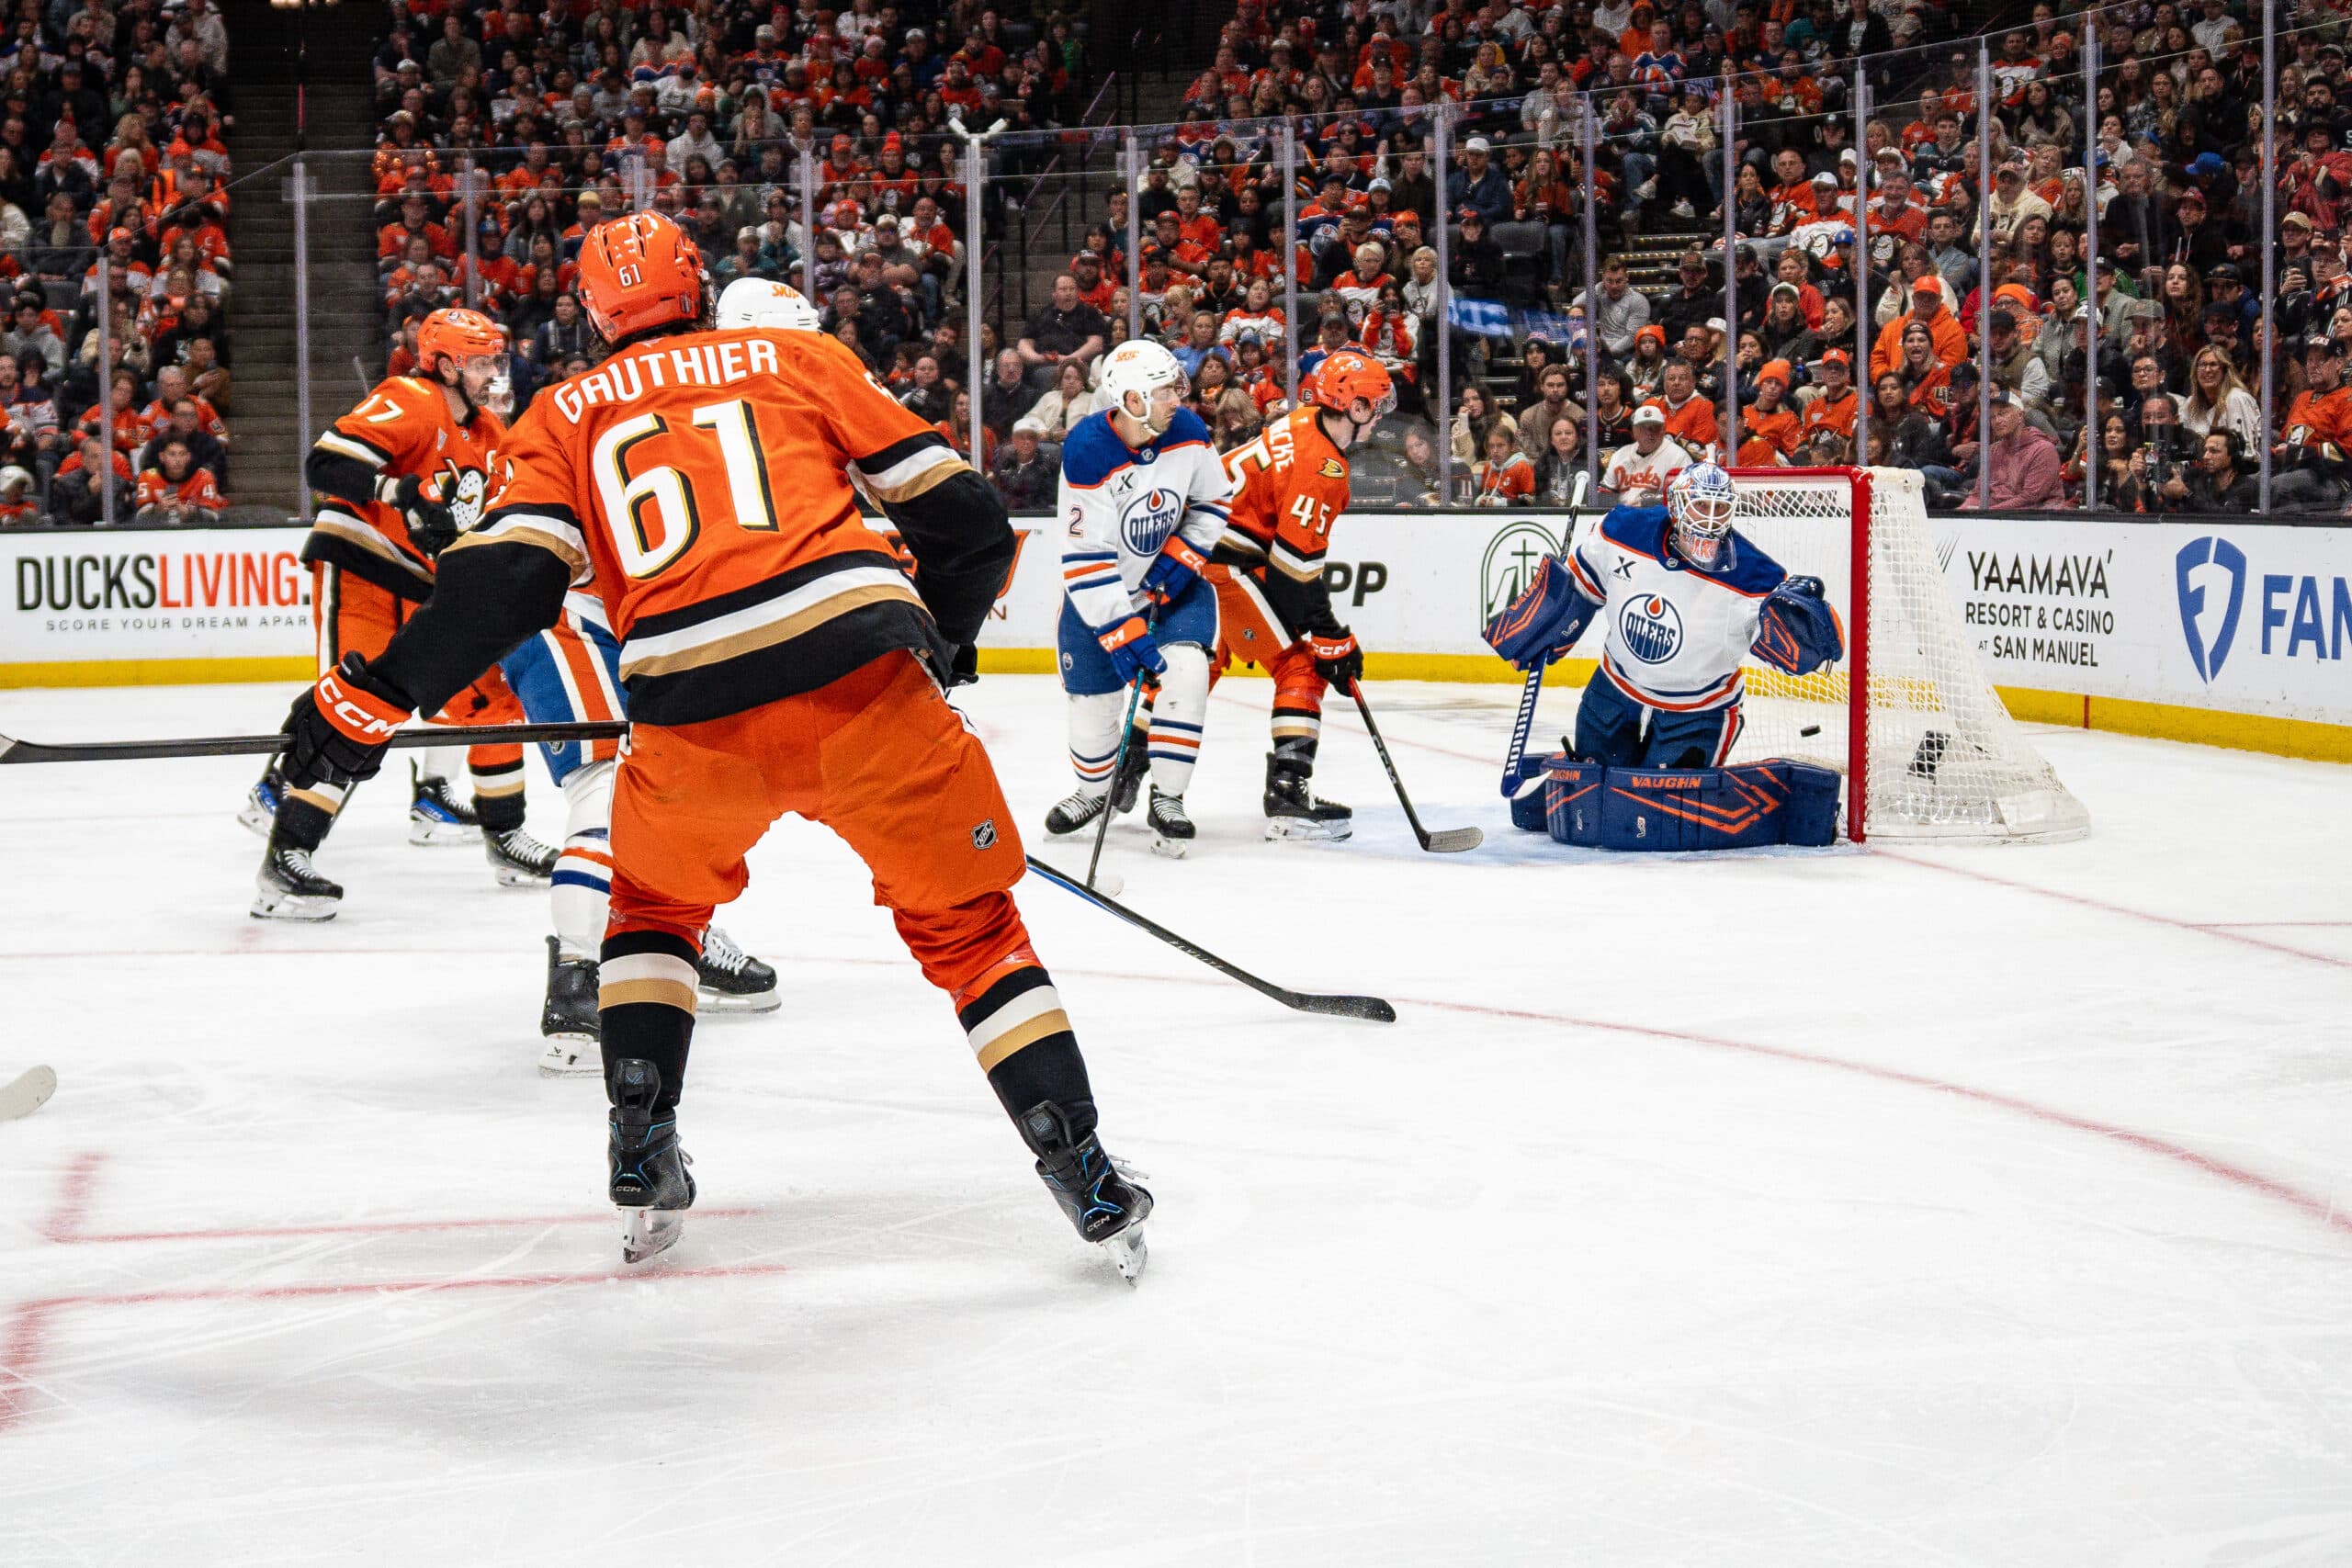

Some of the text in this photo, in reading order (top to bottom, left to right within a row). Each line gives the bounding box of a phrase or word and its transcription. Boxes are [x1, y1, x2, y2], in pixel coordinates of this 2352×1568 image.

[618, 264, 642, 287] 61
[553, 339, 779, 425] GAUTHIER
[352, 394, 404, 423] 17
[593, 399, 778, 579] 61
[1613, 465, 1662, 492] Ducks
[1069, 504, 1084, 537] 2
[1129, 508, 1176, 549] OILERS
[1290, 493, 1331, 536] 45
[46, 615, 308, 632] SCORE YOUR DREAM APAR
[1625, 611, 1677, 656] OILERS
[1965, 602, 2114, 635] RESORT & CASINO
[1978, 635, 2099, 667] AT SAN MANUEL
[319, 676, 405, 737] CCM
[1505, 671, 1540, 777] WARRIOR
[1631, 776, 1702, 789] VAUGHN
[1087, 1215, 1111, 1232] CCM
